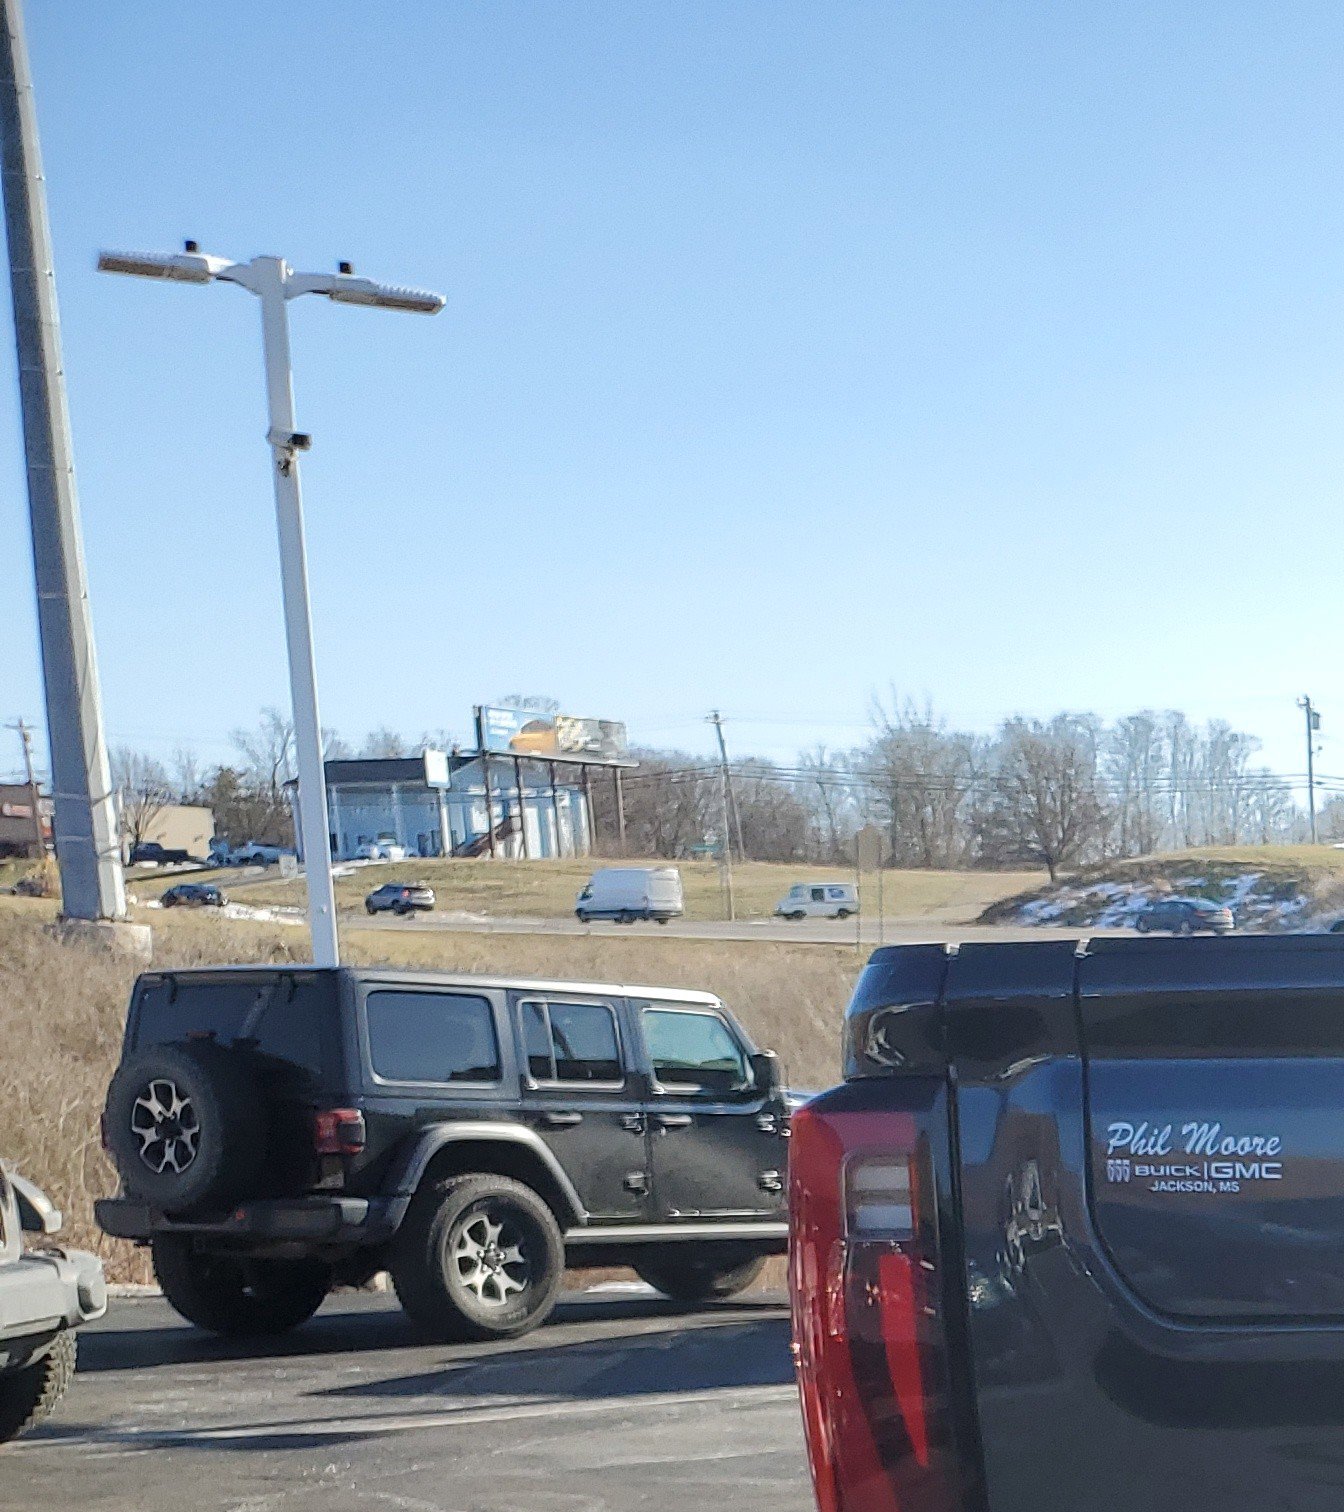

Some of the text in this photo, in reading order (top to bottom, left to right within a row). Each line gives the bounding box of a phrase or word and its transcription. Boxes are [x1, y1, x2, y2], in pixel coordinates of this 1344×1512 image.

[1106, 1121, 1283, 1157] Phil Moore
[1134, 1161, 1284, 1180] BUICK GMC
[1150, 1180, 1241, 1194] JACKSON, MS
